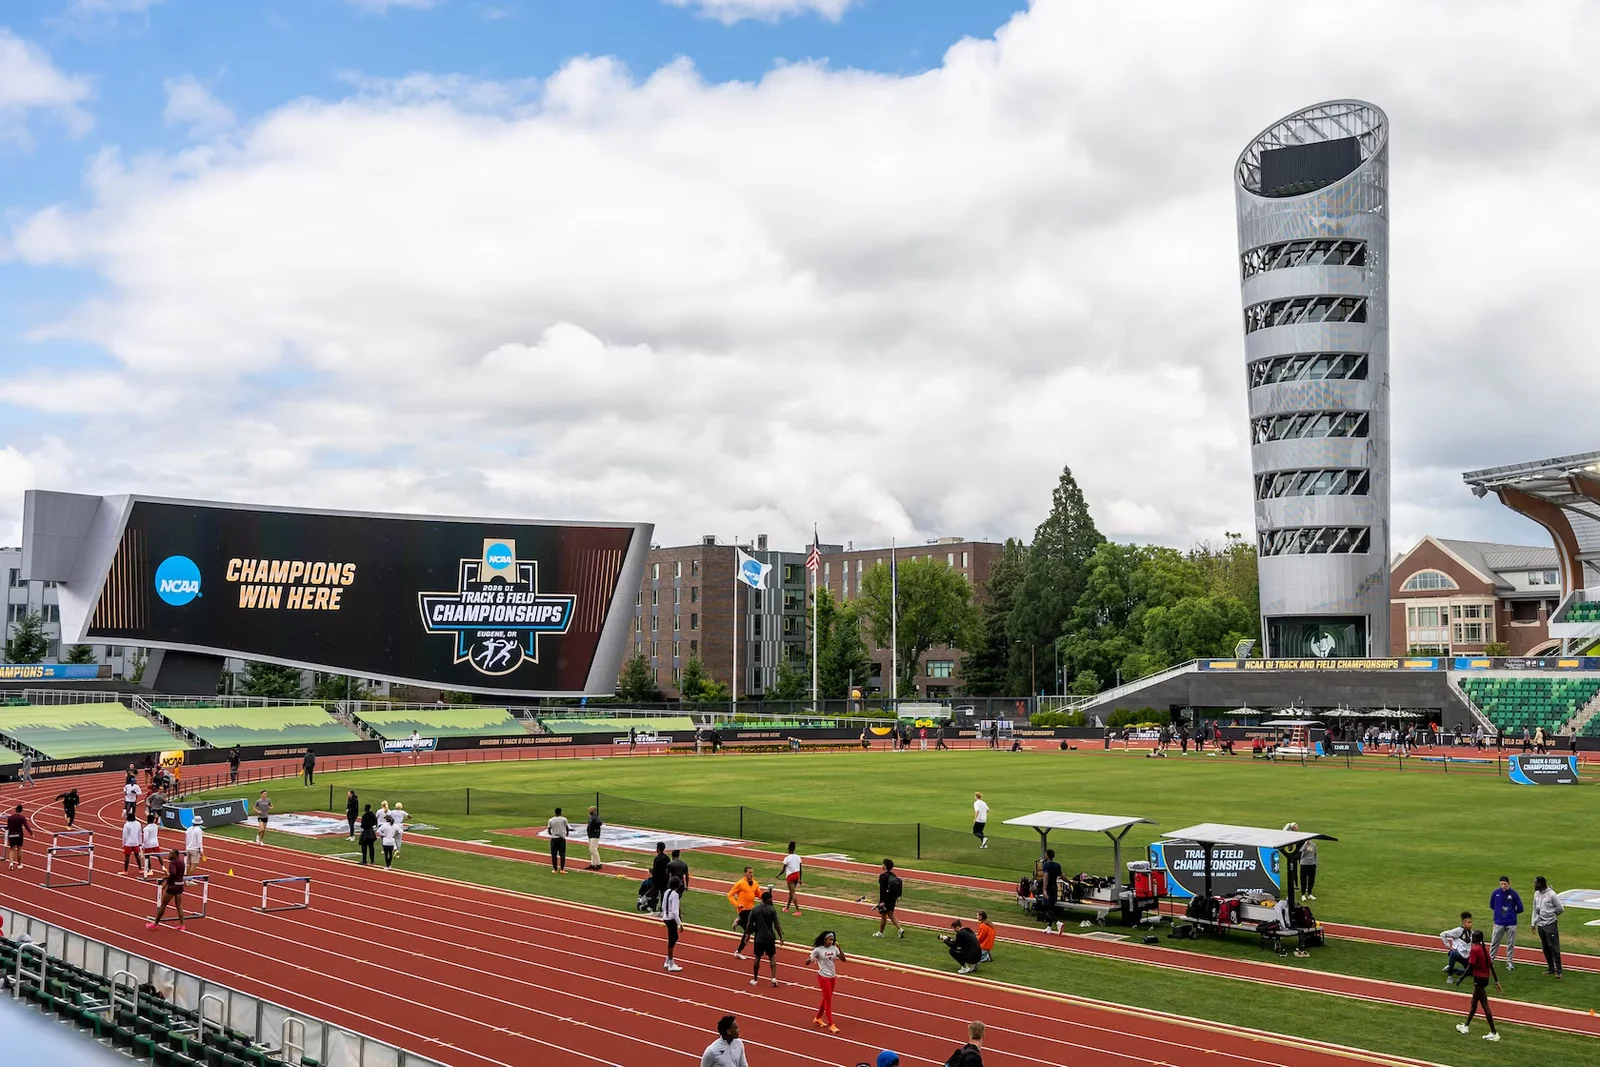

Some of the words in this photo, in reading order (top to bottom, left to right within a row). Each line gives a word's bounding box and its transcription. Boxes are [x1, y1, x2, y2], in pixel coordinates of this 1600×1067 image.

[488, 555, 512, 564] NCAA
[226, 558, 357, 585] CHAMPIONS
[159, 579, 199, 593] NCAA
[239, 585, 282, 609] WIN
[286, 586, 344, 611] HERE
[461, 592, 495, 603] TRACK
[496, 593, 504, 603] &
[506, 592, 535, 604] FIELD
[432, 604, 563, 623] CHAMPIONSHIPS
[1244, 660, 1264, 669] NCAA
[1275, 660, 1298, 669] TRACK
[1299, 660, 1315, 669] AND
[1316, 660, 1335, 669] FIELD
[1337, 660, 1399, 669] CHAMPIONSHIPS
[535, 736, 573, 744] CHAMPIONSHIPS
[68, 761, 104, 770] CHAMPIONSHIPS
[162, 756, 183, 767] NCAA
[1185, 850, 1206, 859] TRAC
[1212, 850, 1220, 859] &
[1220, 850, 1244, 859] FIELD
